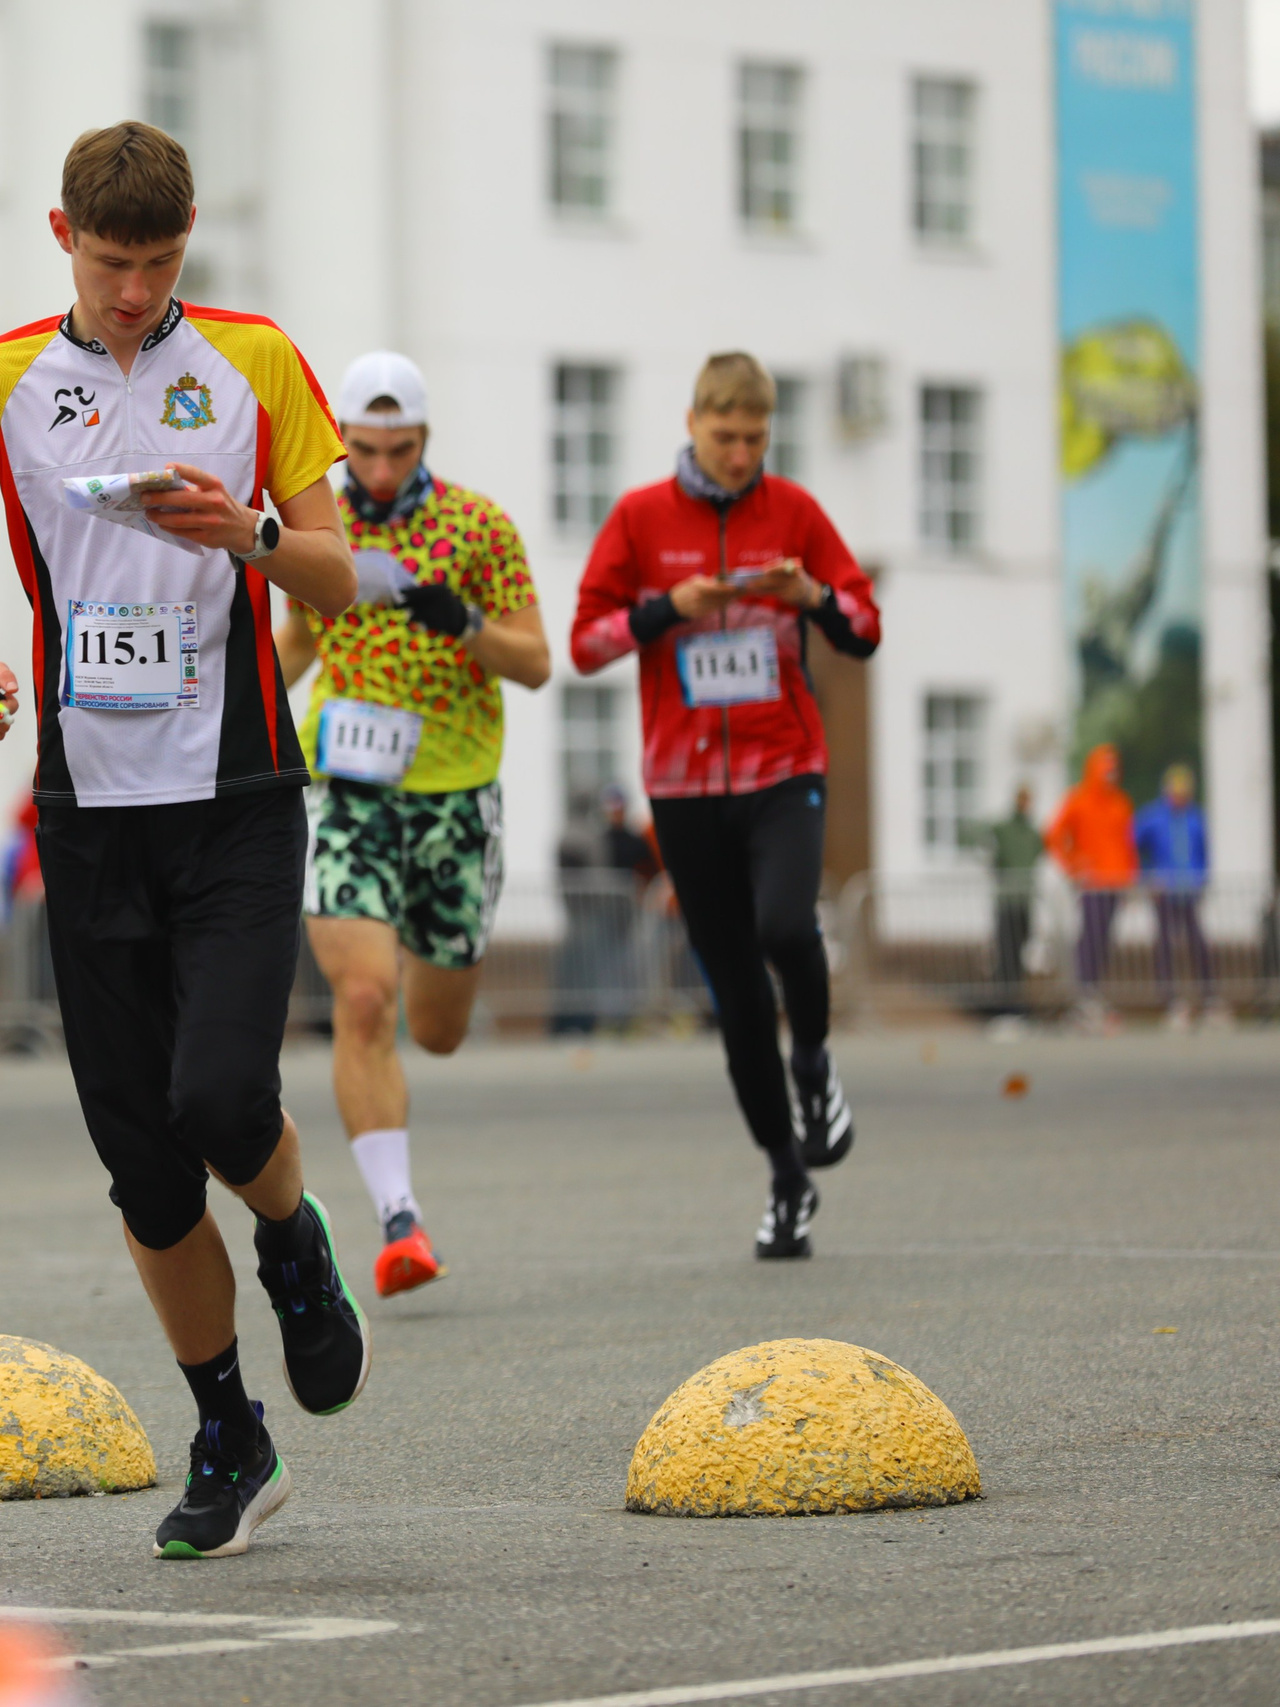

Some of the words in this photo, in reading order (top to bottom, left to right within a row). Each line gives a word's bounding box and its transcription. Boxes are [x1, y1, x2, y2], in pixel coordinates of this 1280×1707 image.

[78, 629, 171, 665] 115.1
[695, 648, 758, 679] 114.1
[337, 723, 400, 754] 111.1
